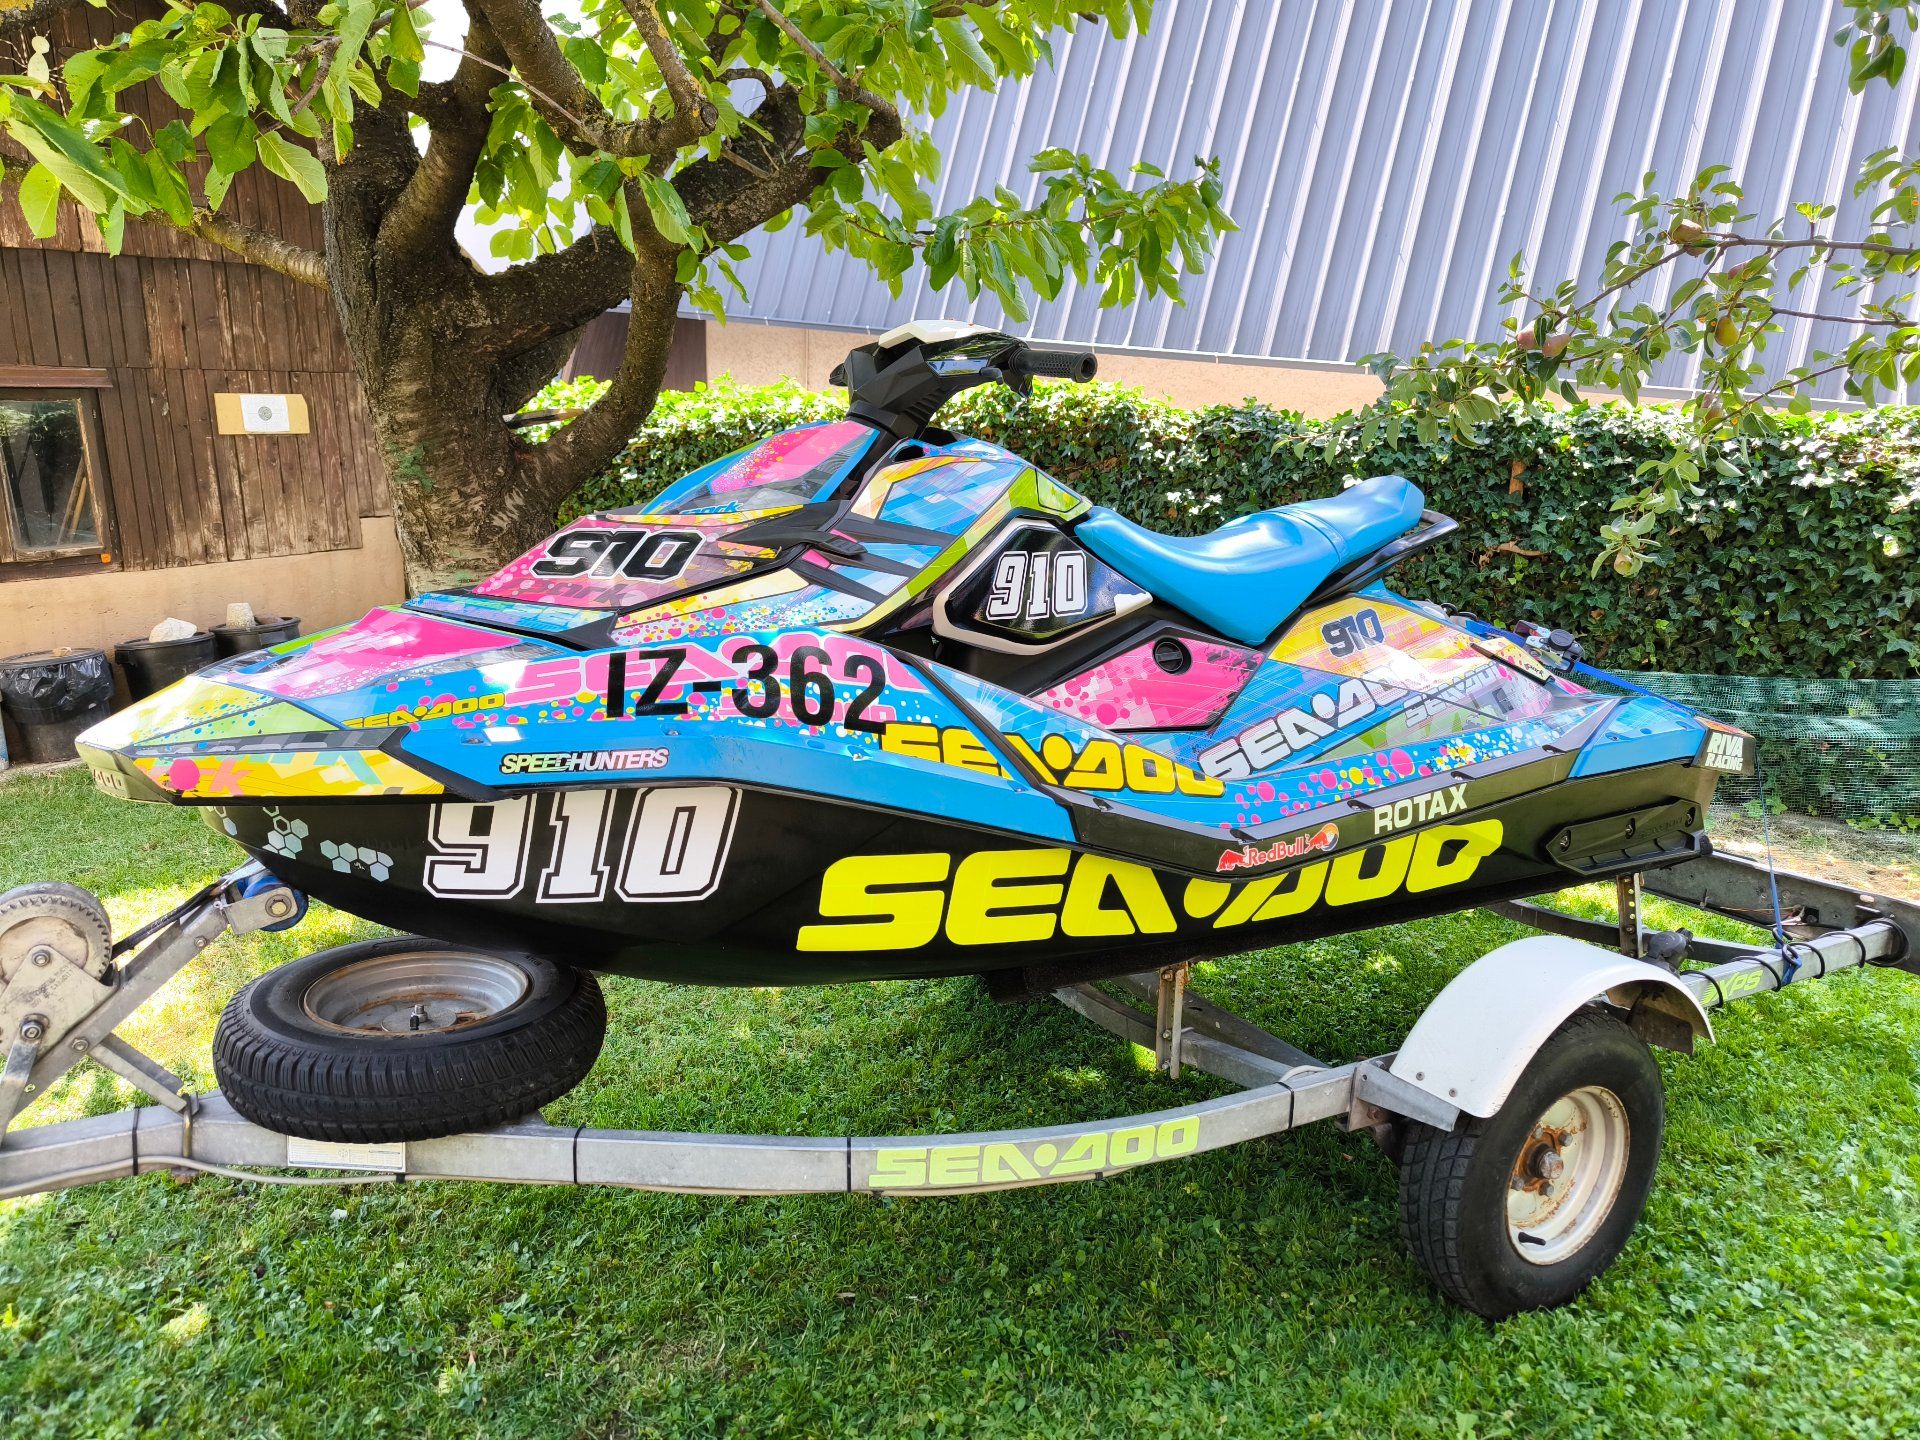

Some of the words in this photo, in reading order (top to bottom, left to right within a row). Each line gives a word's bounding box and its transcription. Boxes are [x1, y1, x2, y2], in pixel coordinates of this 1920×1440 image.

[529, 528, 707, 585] 910
[985, 550, 1088, 620] 910
[1320, 607, 1385, 659] 910
[606, 643, 887, 736] IZ-362
[500, 747, 670, 775] SPEEDHUNTERS
[1704, 752, 1744, 771] RACING
[1706, 731, 1744, 758] RIVA
[1374, 784, 1468, 835] ROTAX
[422, 785, 744, 904] 910
